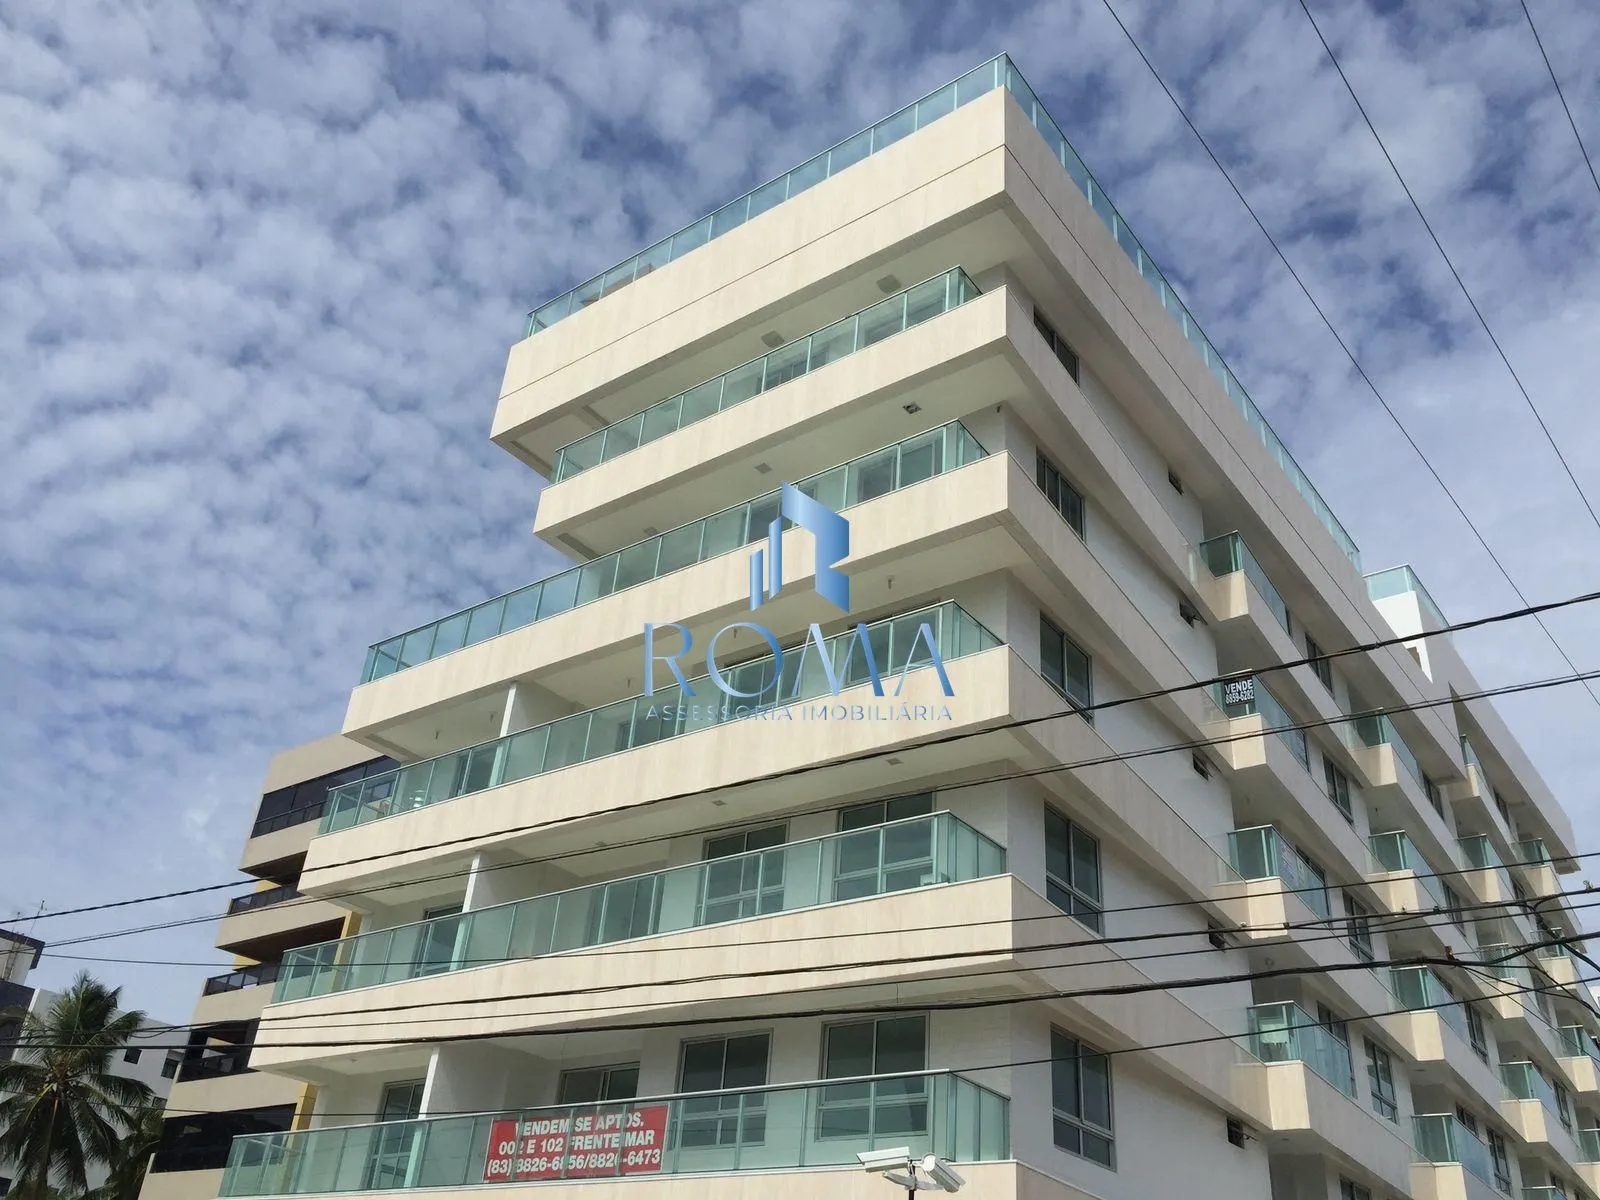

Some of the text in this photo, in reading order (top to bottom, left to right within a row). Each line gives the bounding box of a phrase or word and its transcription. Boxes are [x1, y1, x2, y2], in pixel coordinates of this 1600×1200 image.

[1224, 679, 1253, 694] VENDE
[574, 1116, 593, 1132] SE
[526, 1139, 537, 1155] E
[541, 1137, 564, 1153] 102
[624, 1129, 655, 1147] MAR
[486, 1158, 513, 1177] (83)
